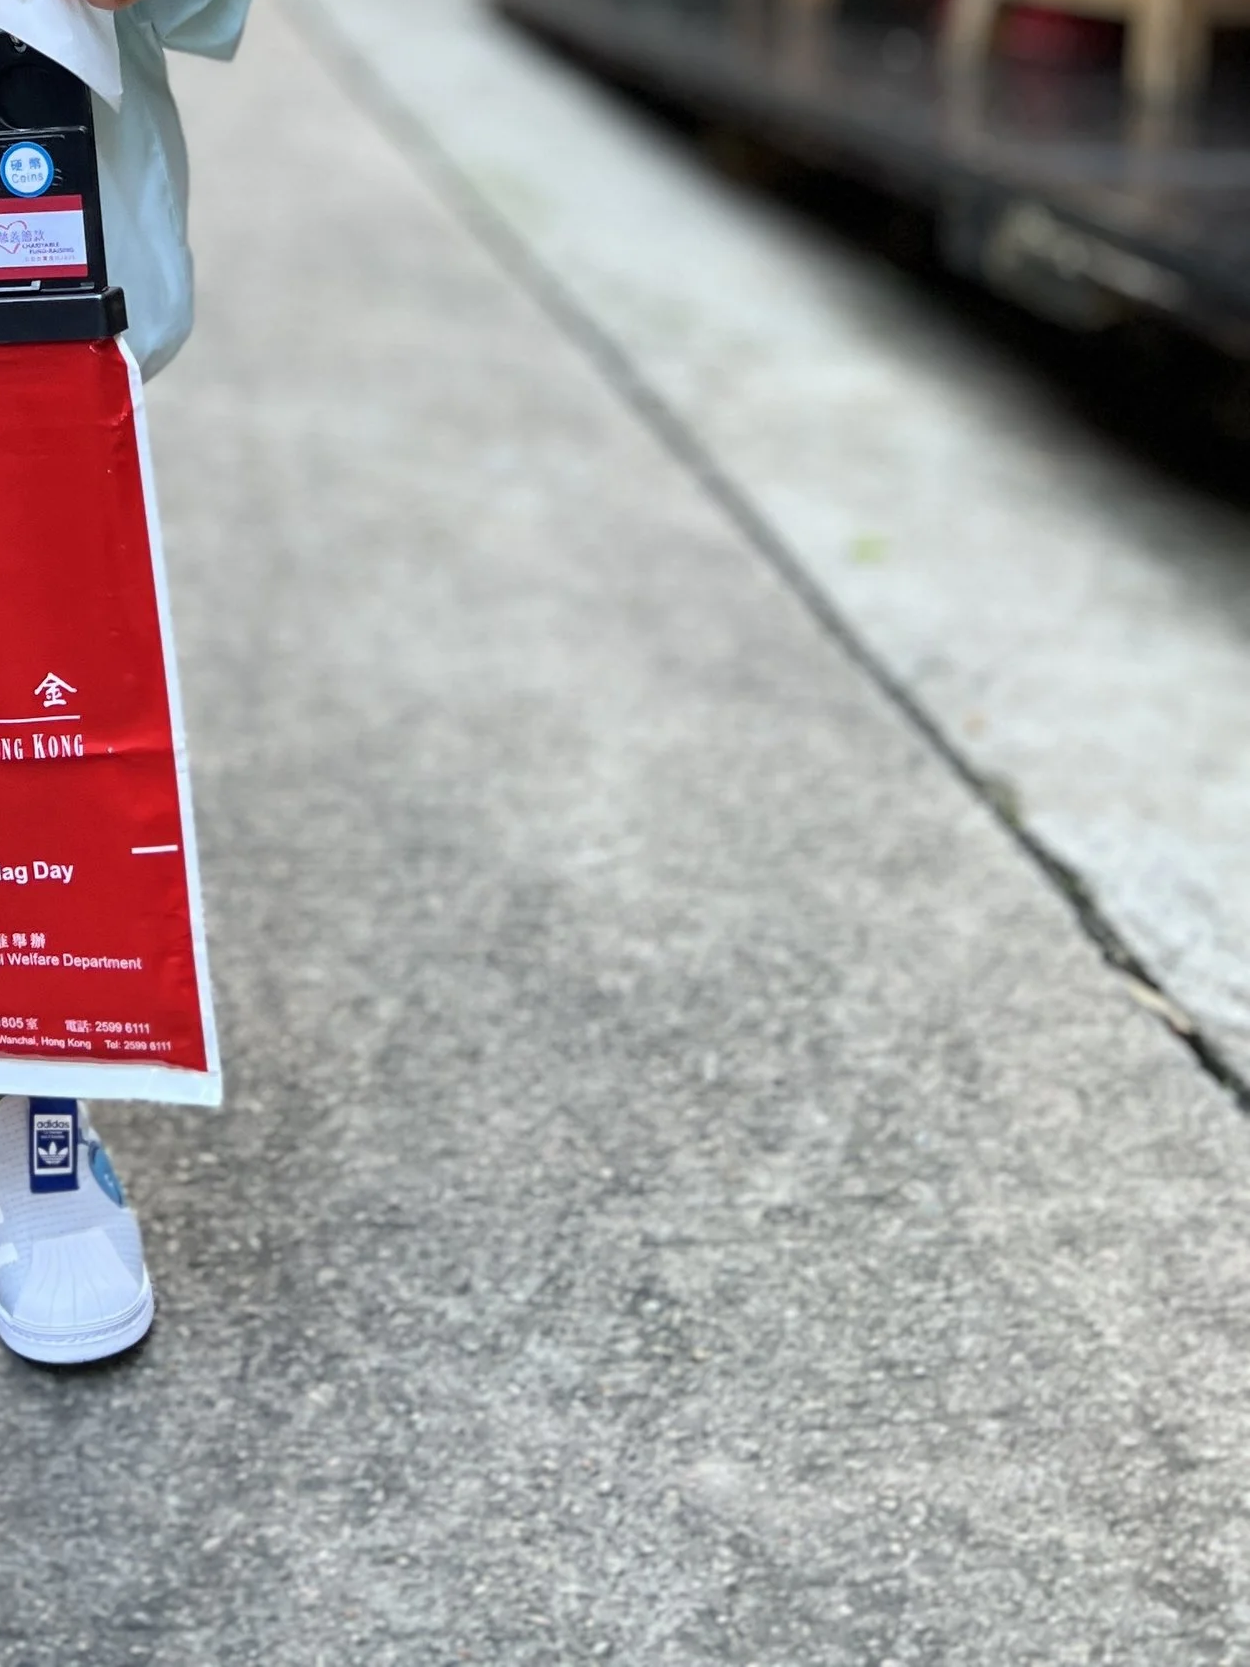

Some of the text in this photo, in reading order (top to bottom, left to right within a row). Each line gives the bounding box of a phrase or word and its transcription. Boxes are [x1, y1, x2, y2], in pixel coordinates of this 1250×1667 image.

[11, 173, 44, 184] Coins
[33, 732, 85, 759] KONG
[33, 860, 75, 884] Day
[6, 952, 60, 967] Welfare
[62, 953, 143, 971] Department
[95, 1021, 123, 1034] 2599
[125, 1022, 151, 1034] 6111
[41, 1037, 65, 1049] Hong
[67, 1038, 92, 1050] Kong
[104, 1040, 121, 1050] Tel:
[124, 1041, 147, 1051] 2599
[150, 1041, 172, 1051] 6111
[37, 1120, 70, 1129] adidas
